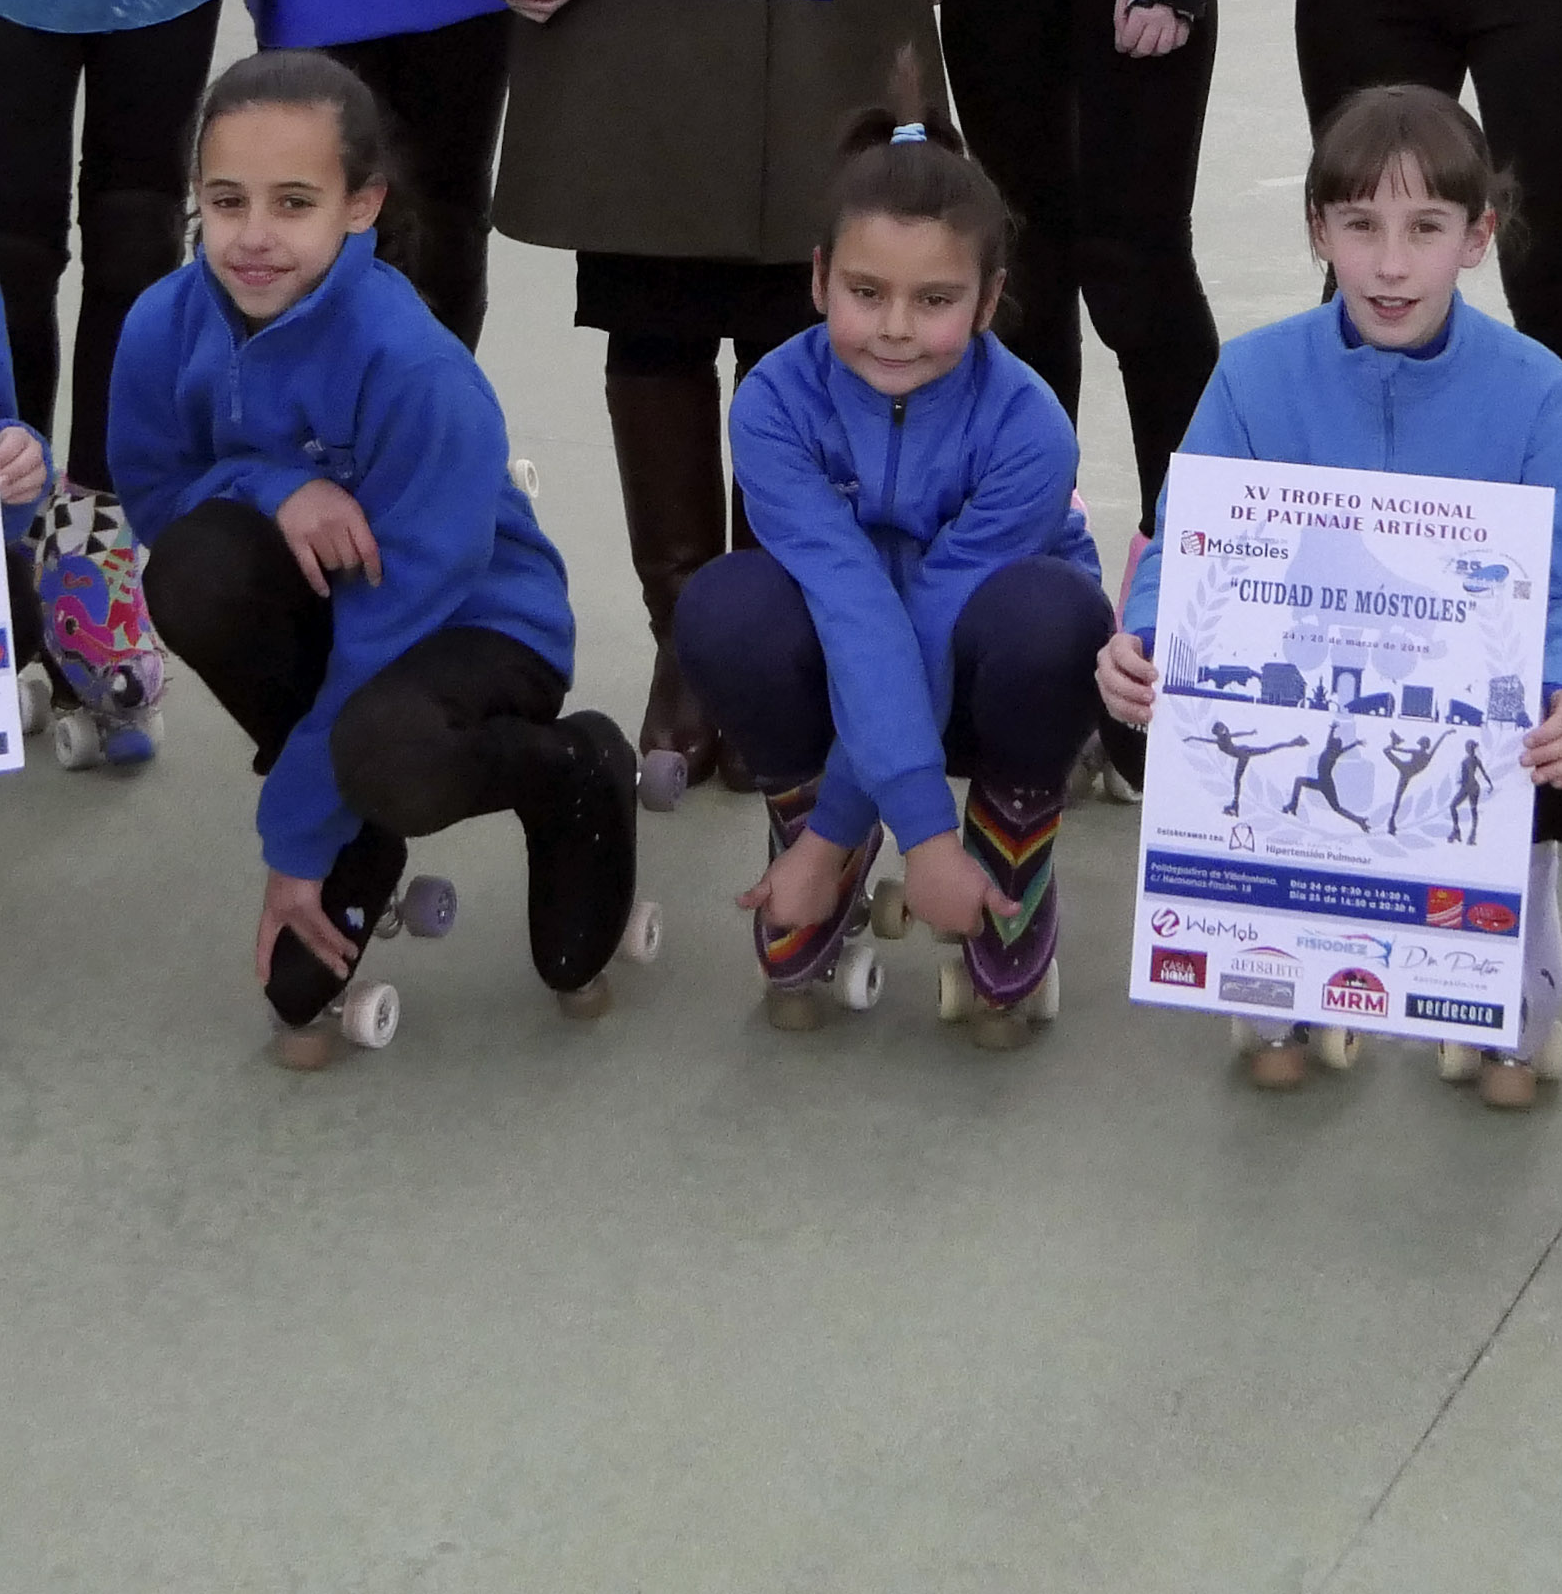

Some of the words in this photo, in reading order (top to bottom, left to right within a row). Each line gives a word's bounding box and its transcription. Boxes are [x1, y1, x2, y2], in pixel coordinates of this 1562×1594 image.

[1243, 485, 1271, 501] XV
[1279, 488, 1362, 509] TROFEO
[1371, 497, 1477, 521] NACIONAL
[1230, 505, 1258, 522] DE
[1267, 509, 1364, 531] PATINAJE
[1374, 516, 1488, 543] ARTÍSTICO
[1207, 537, 1289, 560] Móstoles
[1320, 587, 1348, 611] DE
[1329, 636, 1342, 645] de
[1346, 640, 1381, 649] marzo
[1383, 641, 1397, 651] de
[1266, 844, 1326, 860] Hipertensión
[1327, 851, 1372, 865] Pulmonar
[1210, 869, 1222, 879] de
[1187, 915, 1259, 942] WeMob
[1297, 936, 1368, 956] FISIODIEZ
[1160, 969, 1197, 984] HOME
[1325, 989, 1384, 1013] MRM
[1416, 998, 1493, 1023] verdecora
